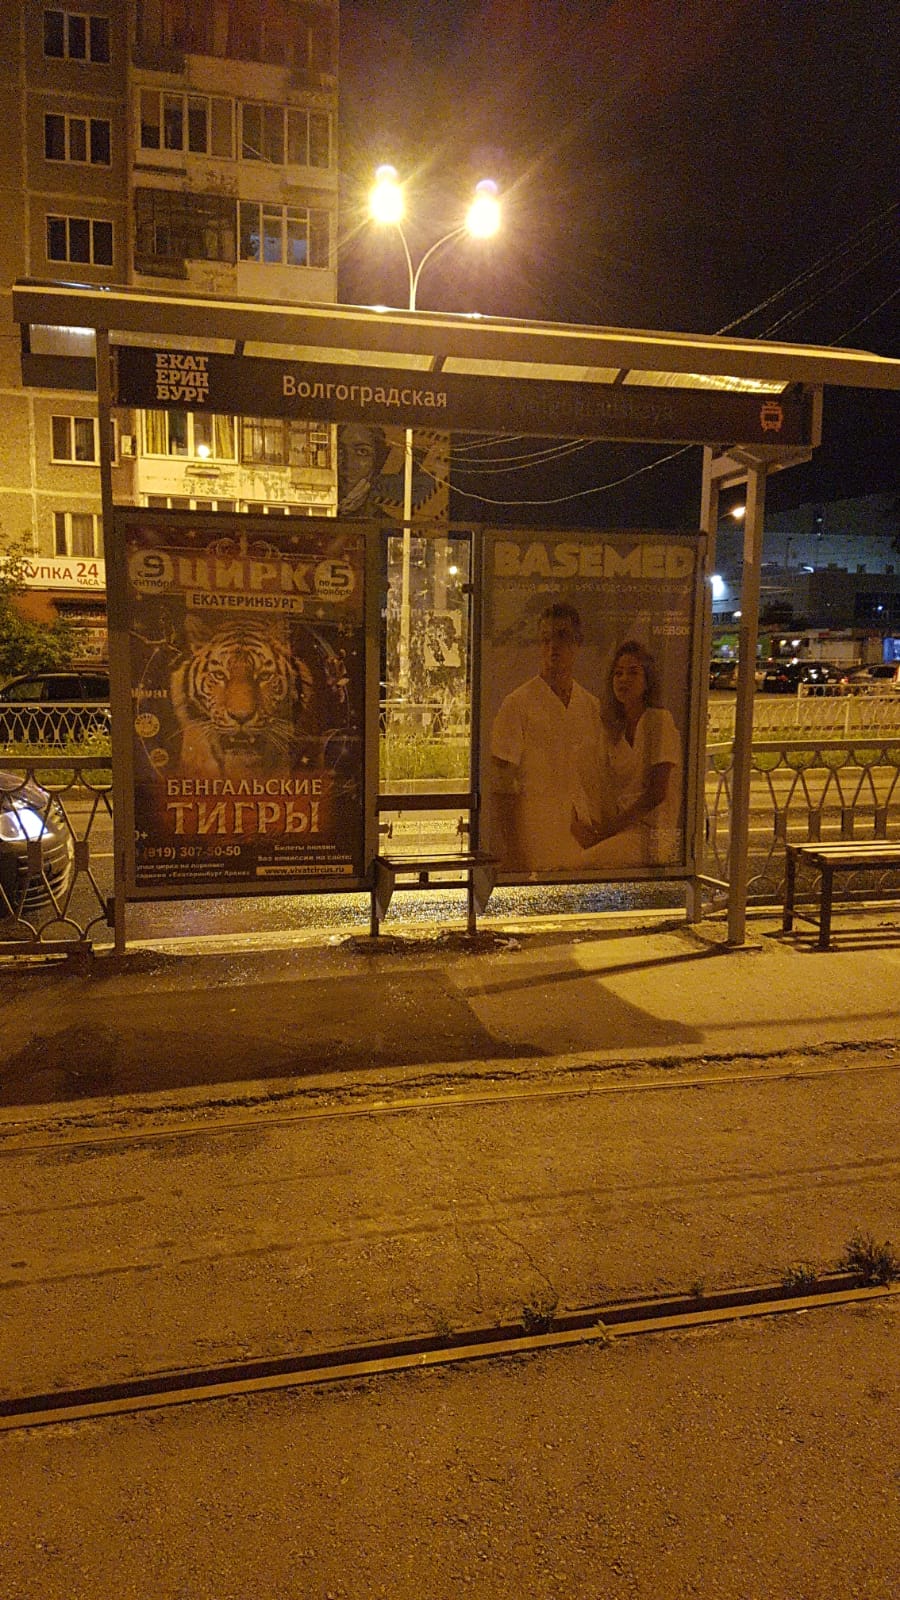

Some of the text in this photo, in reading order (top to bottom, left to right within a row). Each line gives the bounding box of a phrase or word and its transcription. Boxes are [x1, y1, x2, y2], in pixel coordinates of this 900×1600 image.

[155, 353, 209, 371] ЕКАТ
[156, 369, 209, 387] ЕРИН
[156, 385, 209, 403] БУРГ
[282, 375, 448, 408] Волгоградская
[143, 555, 165, 578] 9
[494, 541, 696, 579] BASEMED
[76, 562, 99, 578] 24
[178, 556, 312, 593] ЦИРК
[330, 564, 350, 587] 5
[77, 578, 100, 586] ЧАСА
[192, 593, 299, 609] ЕКАТЕРИНБУРГ
[166, 778, 323, 796] БЕНГАЛЬСКИЕ
[166, 800, 321, 834] ТИГРЫ
